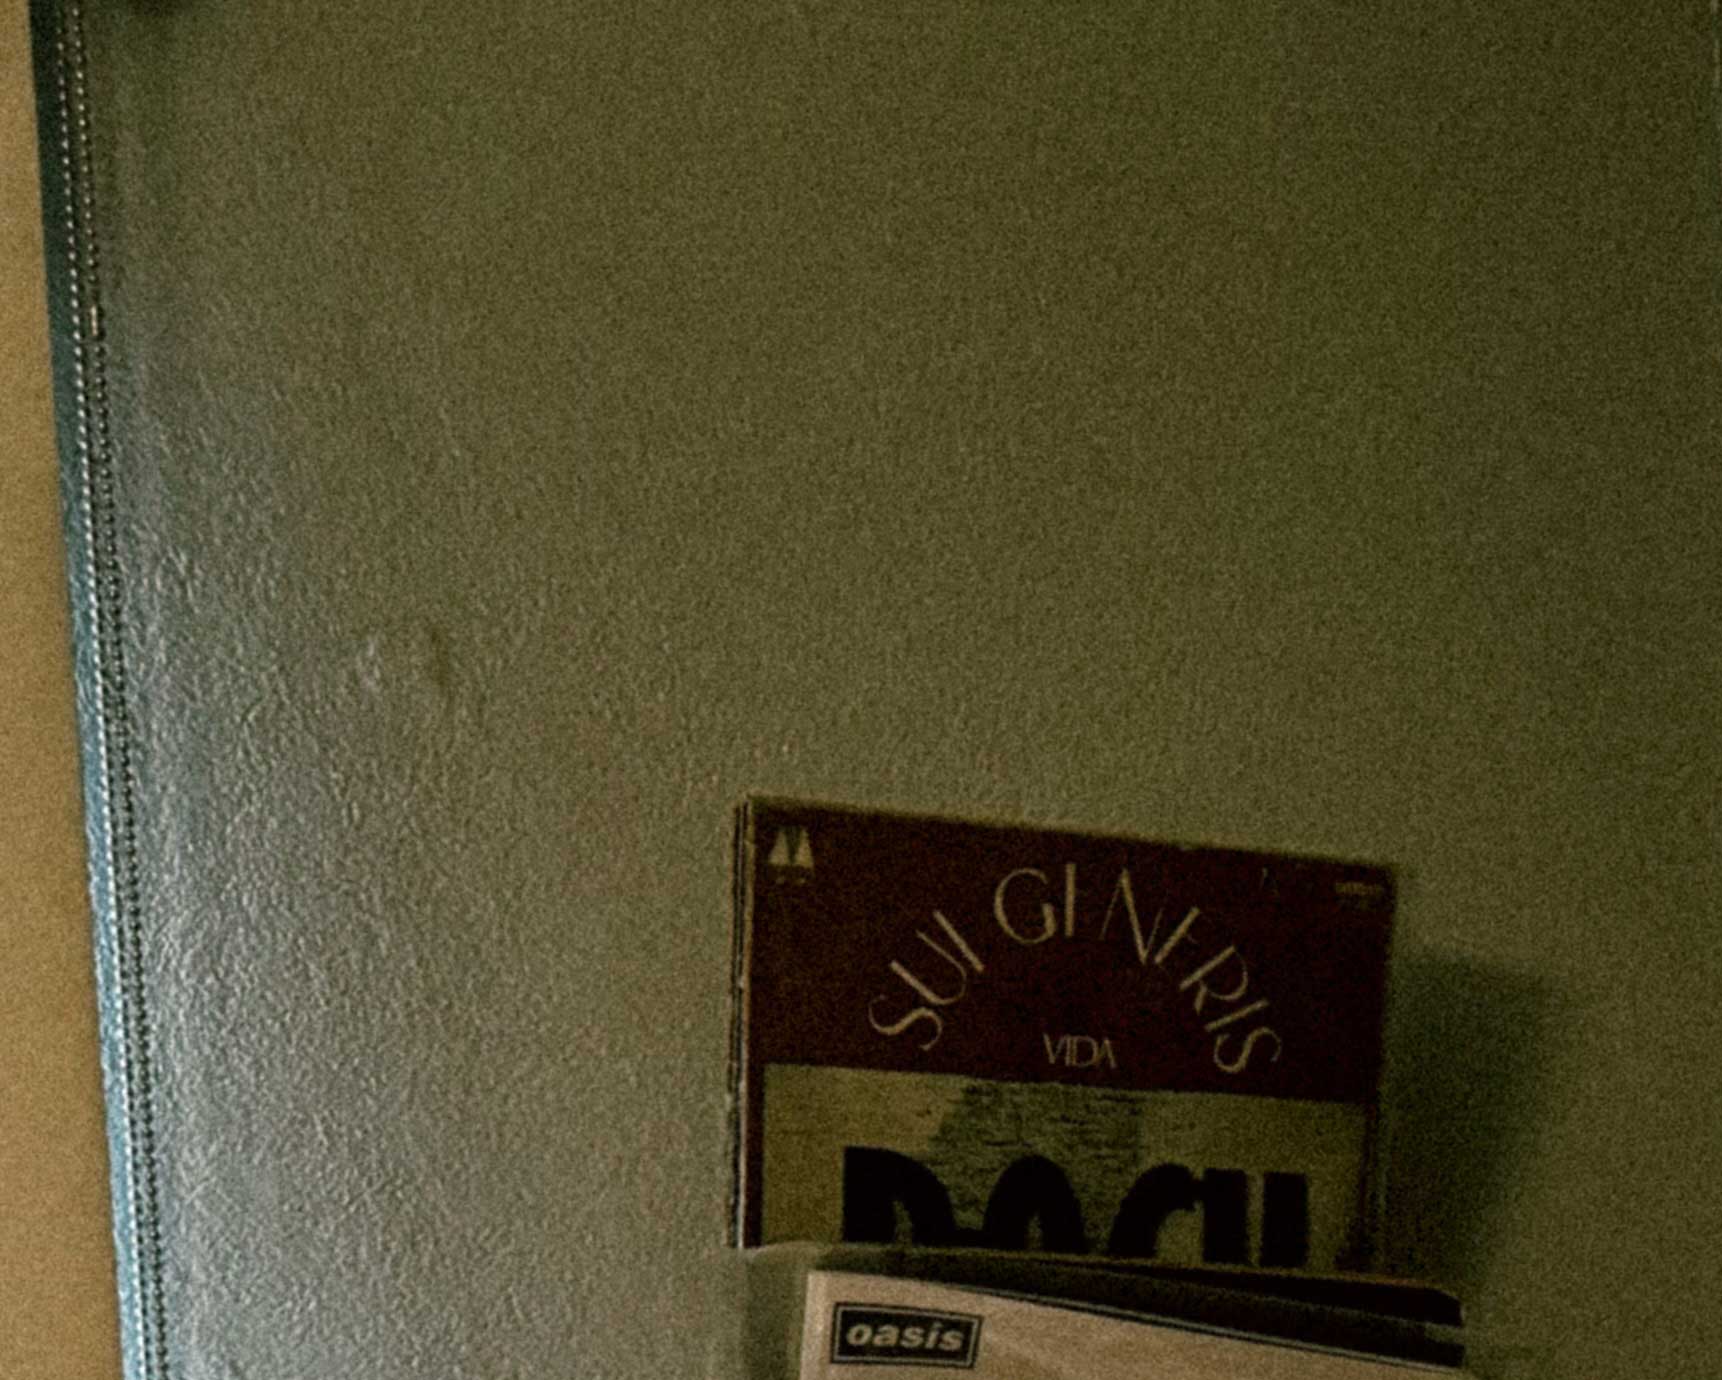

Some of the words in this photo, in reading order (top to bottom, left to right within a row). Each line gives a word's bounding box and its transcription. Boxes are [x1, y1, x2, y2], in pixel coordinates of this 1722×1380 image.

[867, 910, 986, 1051] SUI
[1042, 1032, 1117, 1070] VIDA
[844, 1319, 965, 1355] oasis
